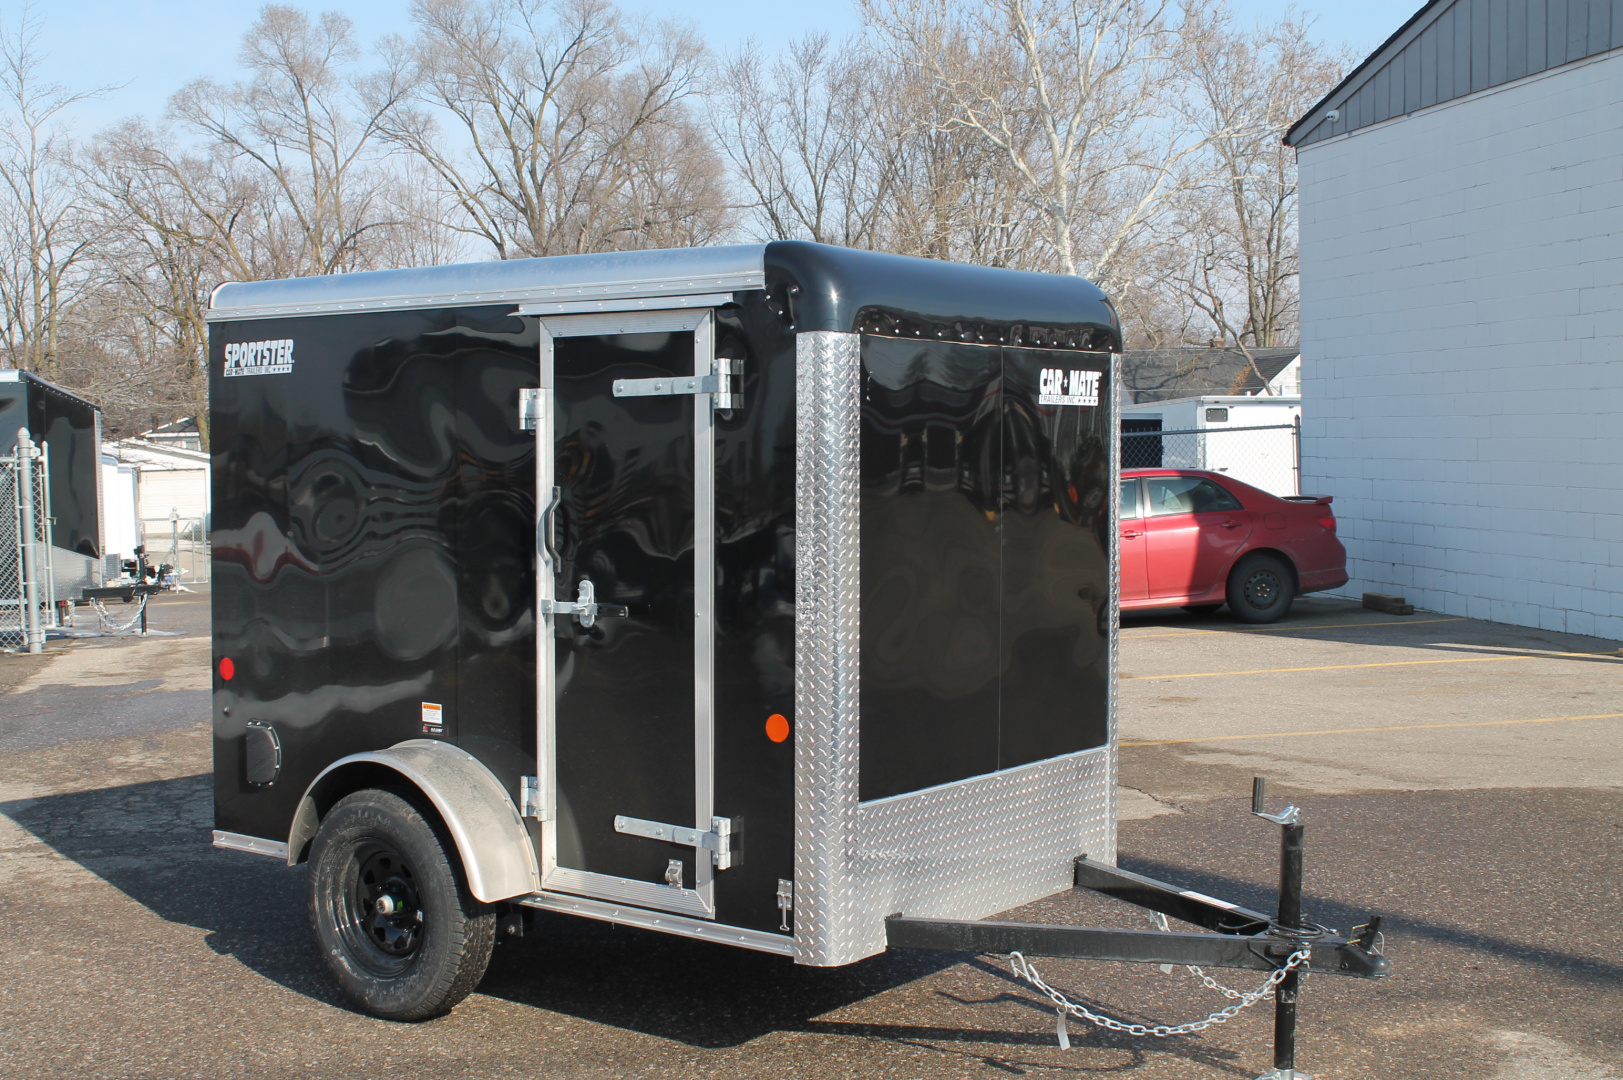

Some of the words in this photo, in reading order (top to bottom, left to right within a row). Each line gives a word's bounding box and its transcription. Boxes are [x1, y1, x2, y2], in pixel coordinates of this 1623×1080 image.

[224, 339, 294, 368] SPORTSTER
[1040, 368, 1063, 395] CAR
[1069, 370, 1099, 396] MATE
[1040, 396, 1066, 404] TRAILERS
